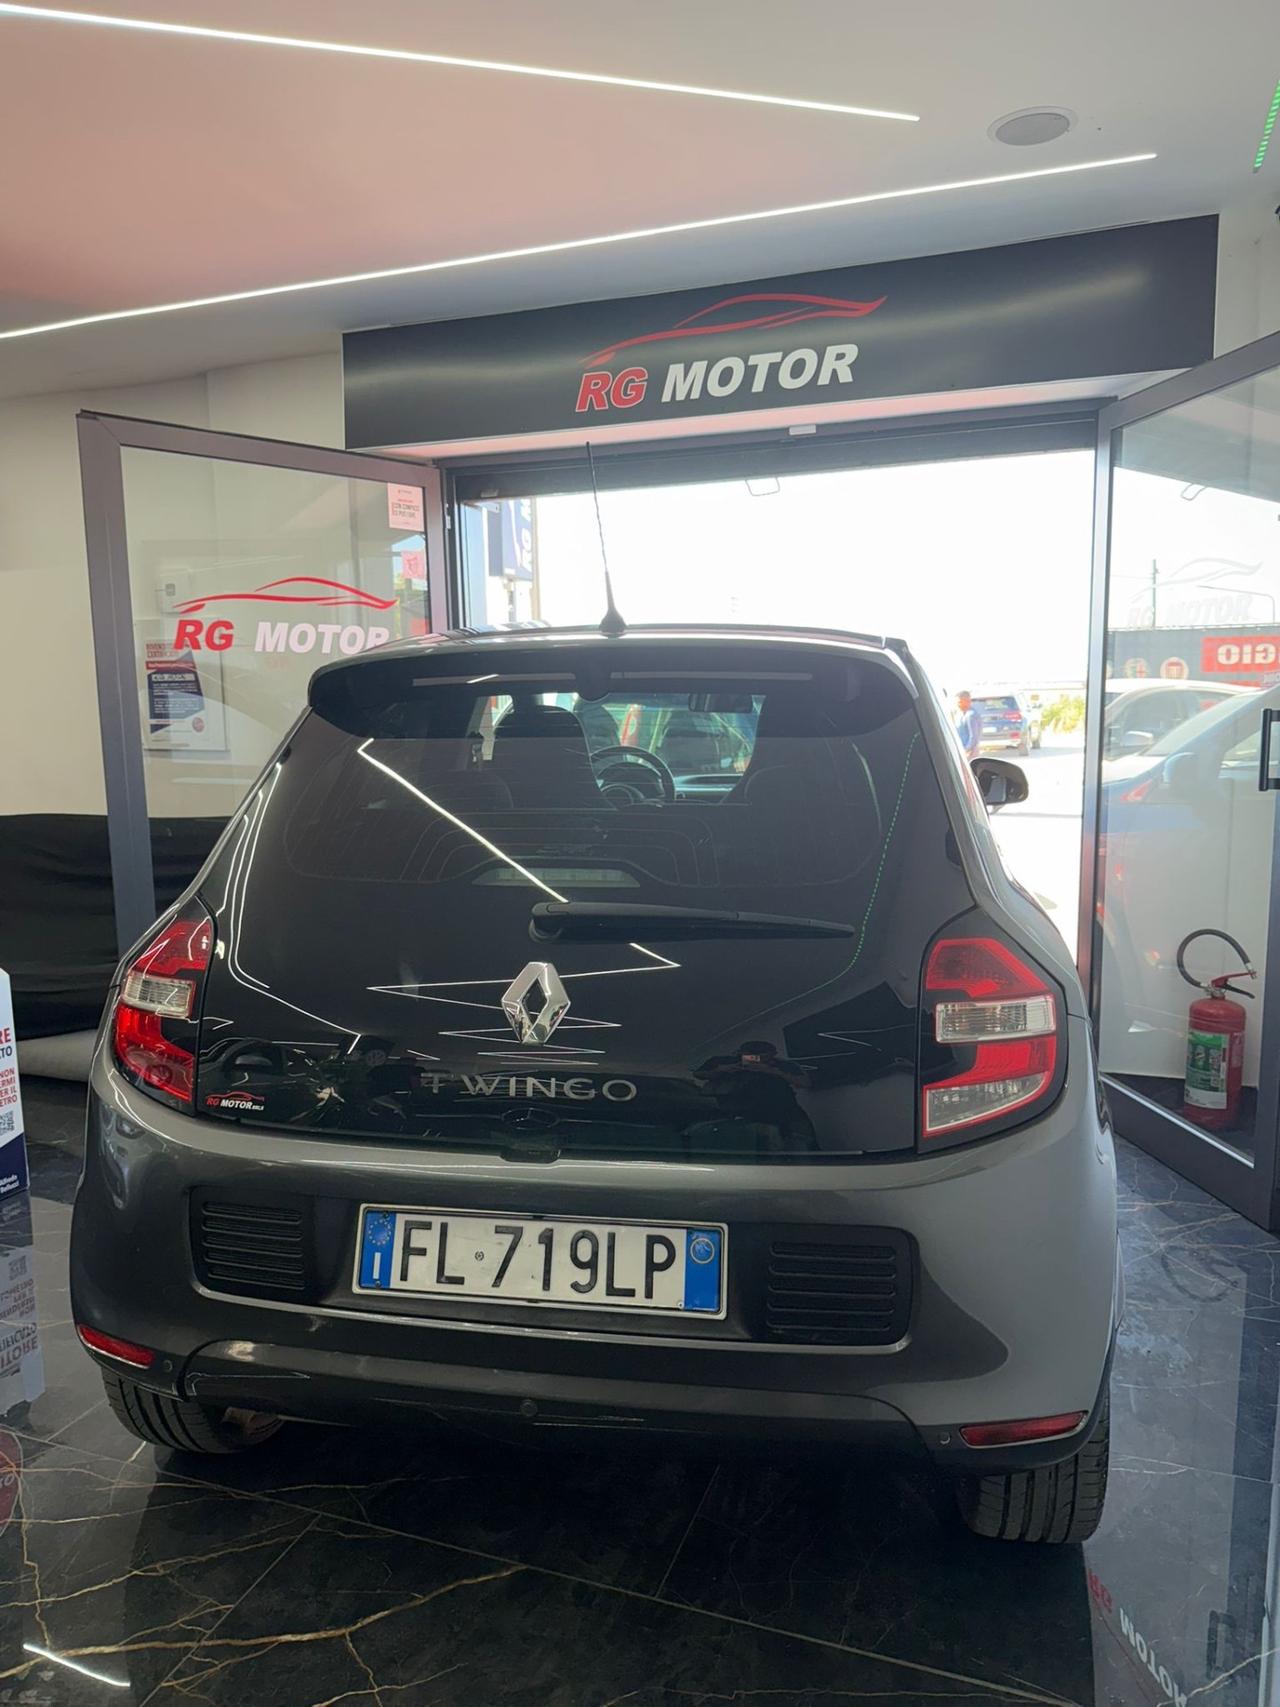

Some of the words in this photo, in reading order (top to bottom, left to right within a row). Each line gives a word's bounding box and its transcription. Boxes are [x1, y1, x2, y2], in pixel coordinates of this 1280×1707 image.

[576, 367, 648, 412] RG
[661, 344, 859, 403] MOTOR
[174, 619, 234, 651] RG
[254, 622, 390, 654] MOTOR
[206, 1097, 220, 1106] RG
[220, 1098, 253, 1110] MOTOR
[421, 1072, 637, 1101] TWINGO
[399, 1219, 465, 1285] FL
